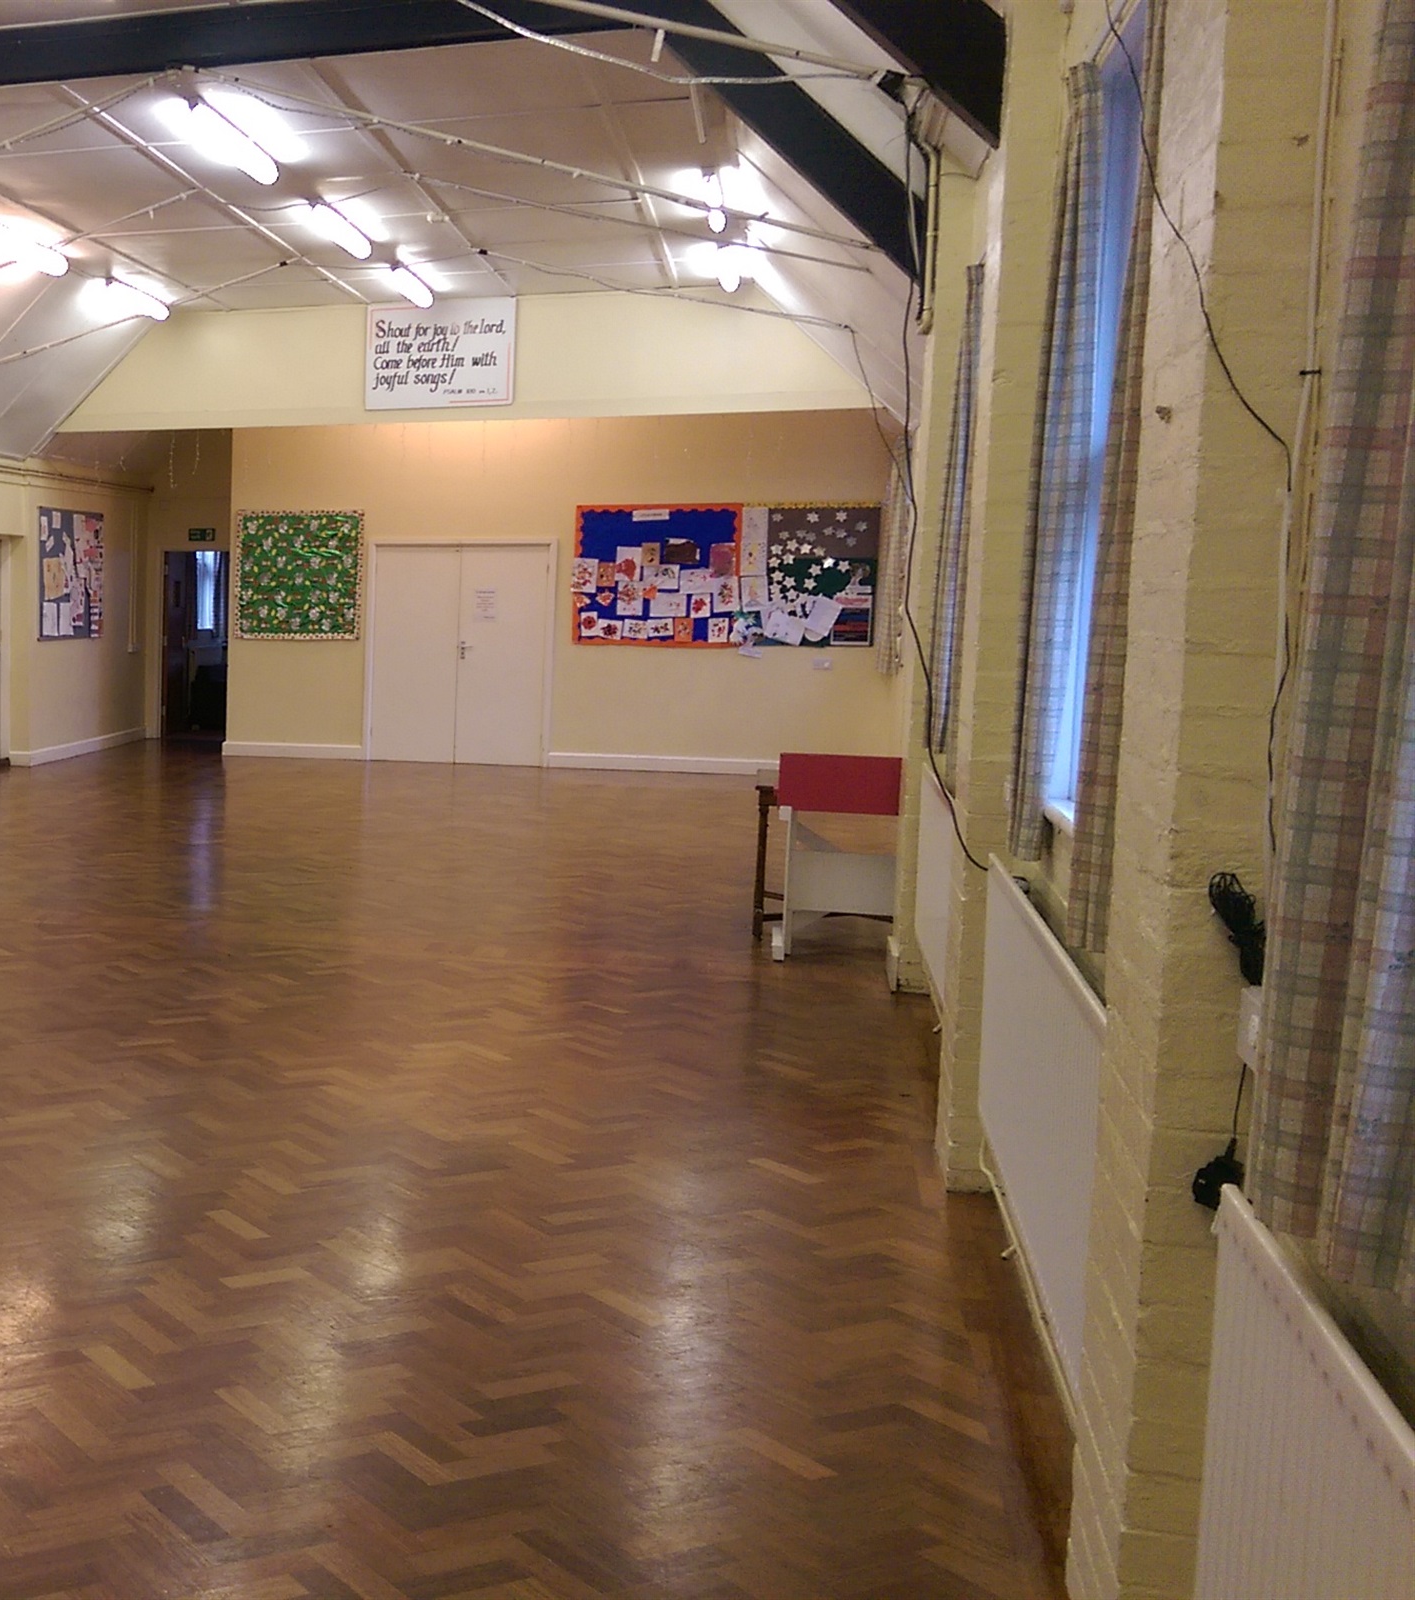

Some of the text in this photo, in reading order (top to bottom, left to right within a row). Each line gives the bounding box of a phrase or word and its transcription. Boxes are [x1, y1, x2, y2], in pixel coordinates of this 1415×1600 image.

[375, 319, 412, 338] Shout
[413, 322, 431, 341] for
[430, 323, 449, 342] joy
[450, 321, 461, 336] to
[463, 319, 479, 335] the
[374, 335, 460, 354] all the earth!
[373, 350, 498, 372] Come before Him with
[372, 368, 457, 393] joyful songs!
